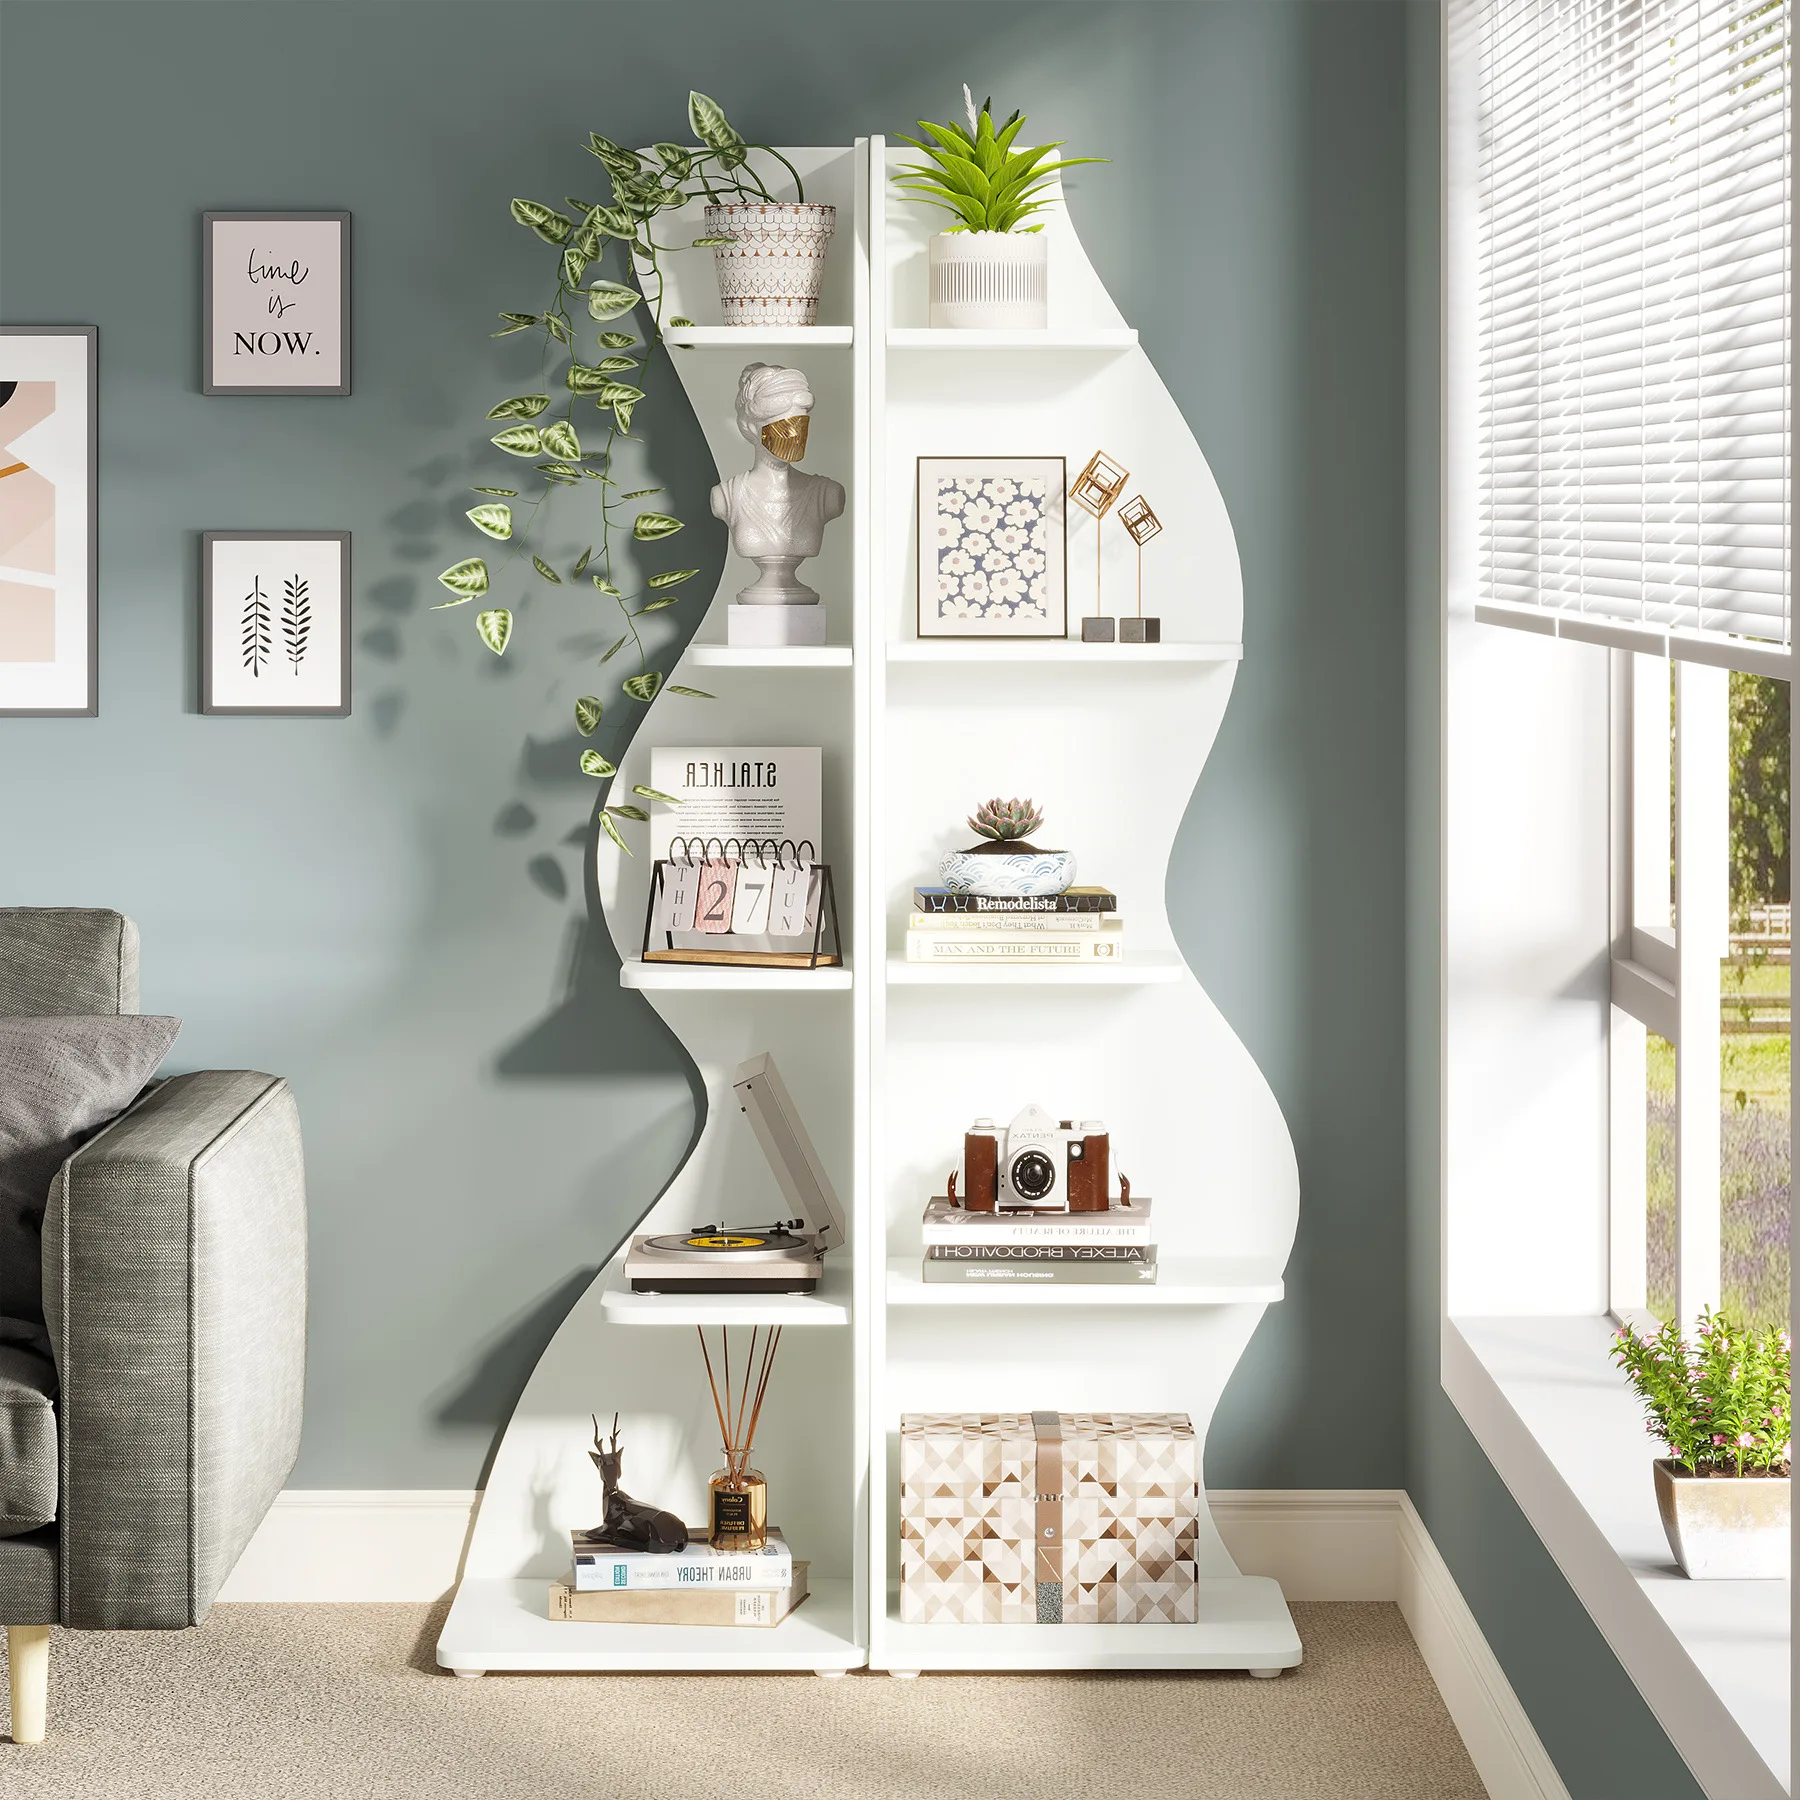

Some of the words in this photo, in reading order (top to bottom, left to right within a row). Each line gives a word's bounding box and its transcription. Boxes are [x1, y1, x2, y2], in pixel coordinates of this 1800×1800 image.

[247, 248, 309, 285] time
[268, 288, 296, 319] is
[233, 331, 320, 356] NOW.
[977, 896, 1058, 910] Remodelista
[982, 922, 1002, 930] Don't
[1002, 920, 1022, 930] They
[1023, 922, 1045, 930] What
[934, 945, 963, 953] MAN
[966, 945, 995, 953] AND
[998, 945, 1026, 953] THE
[1030, 945, 1081, 953] FUTURE
